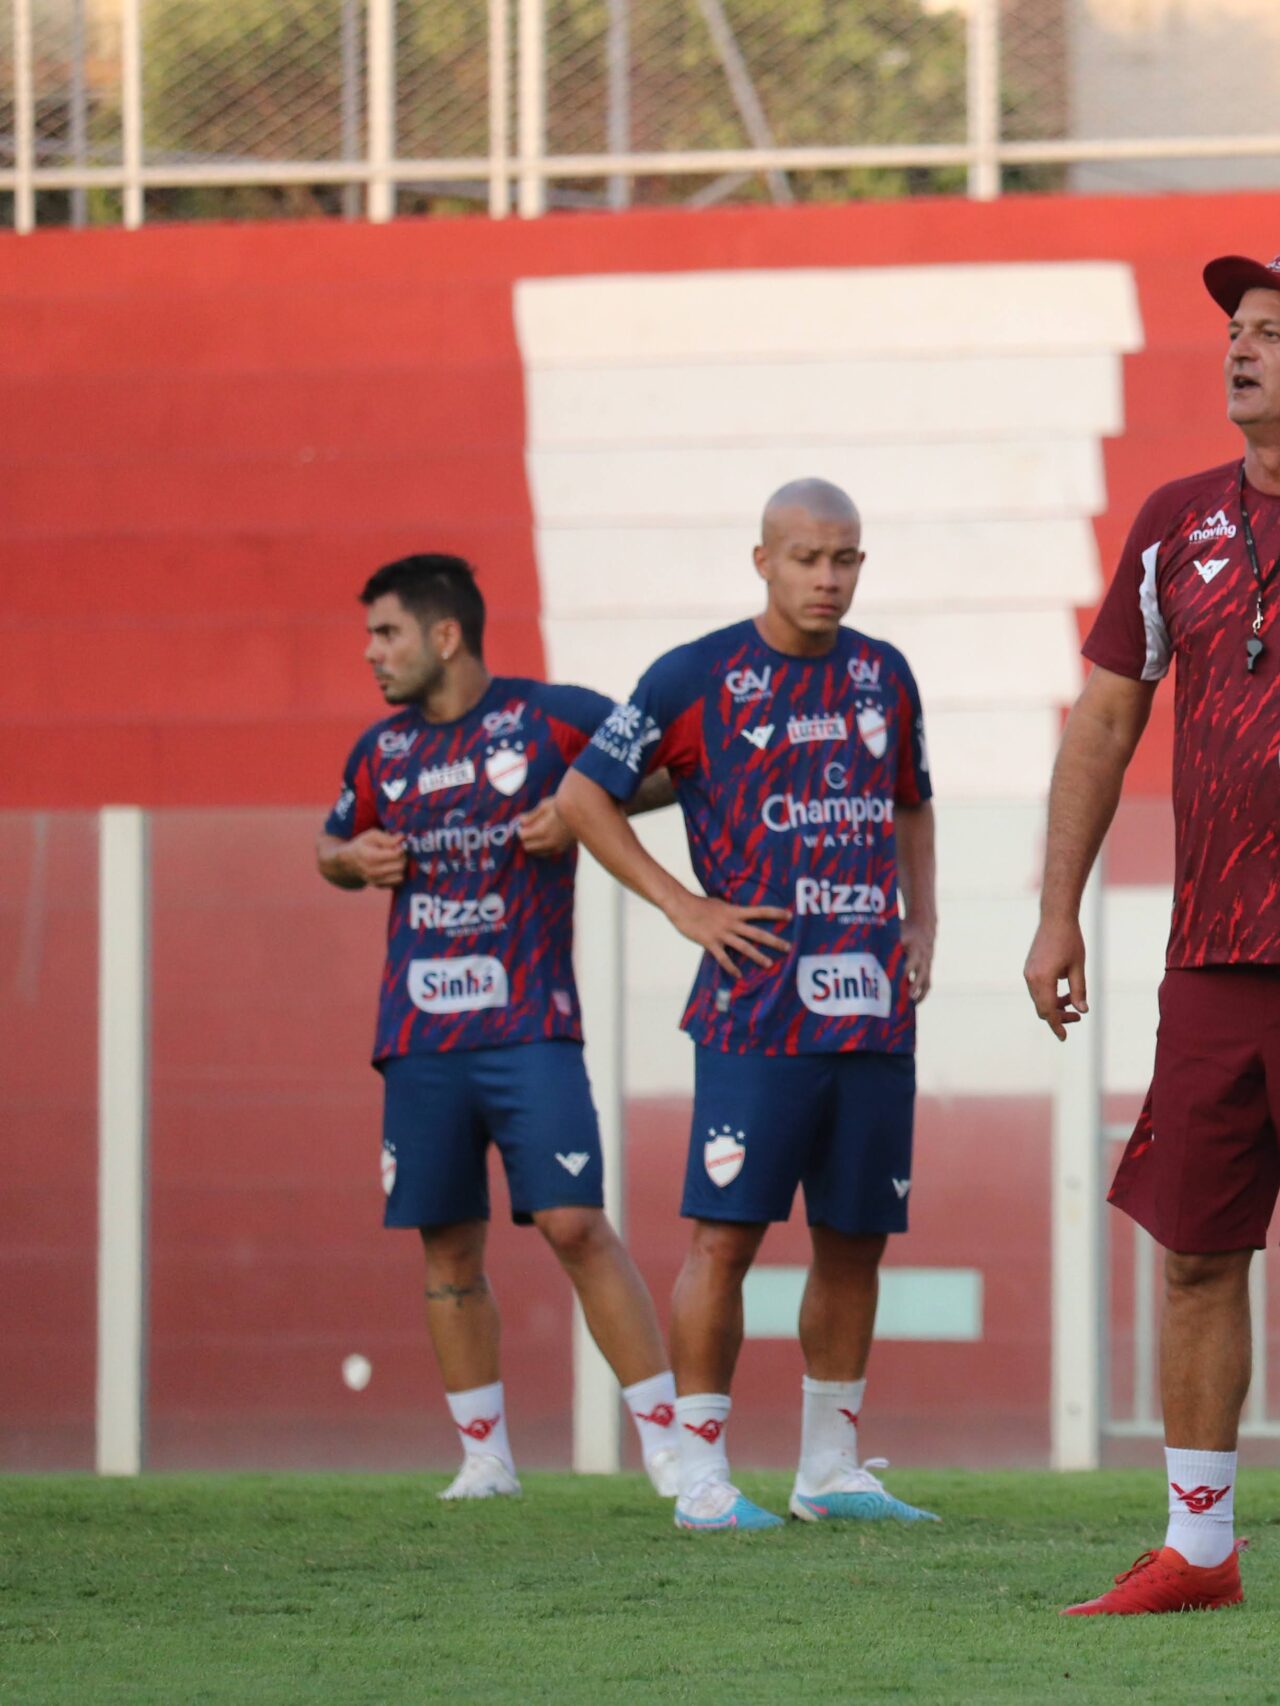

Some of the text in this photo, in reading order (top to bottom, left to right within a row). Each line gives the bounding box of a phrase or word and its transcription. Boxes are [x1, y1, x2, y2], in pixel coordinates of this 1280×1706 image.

[1189, 524, 1237, 542] moving
[410, 892, 506, 930] Rizzo
[796, 877, 886, 915] Rizzo
